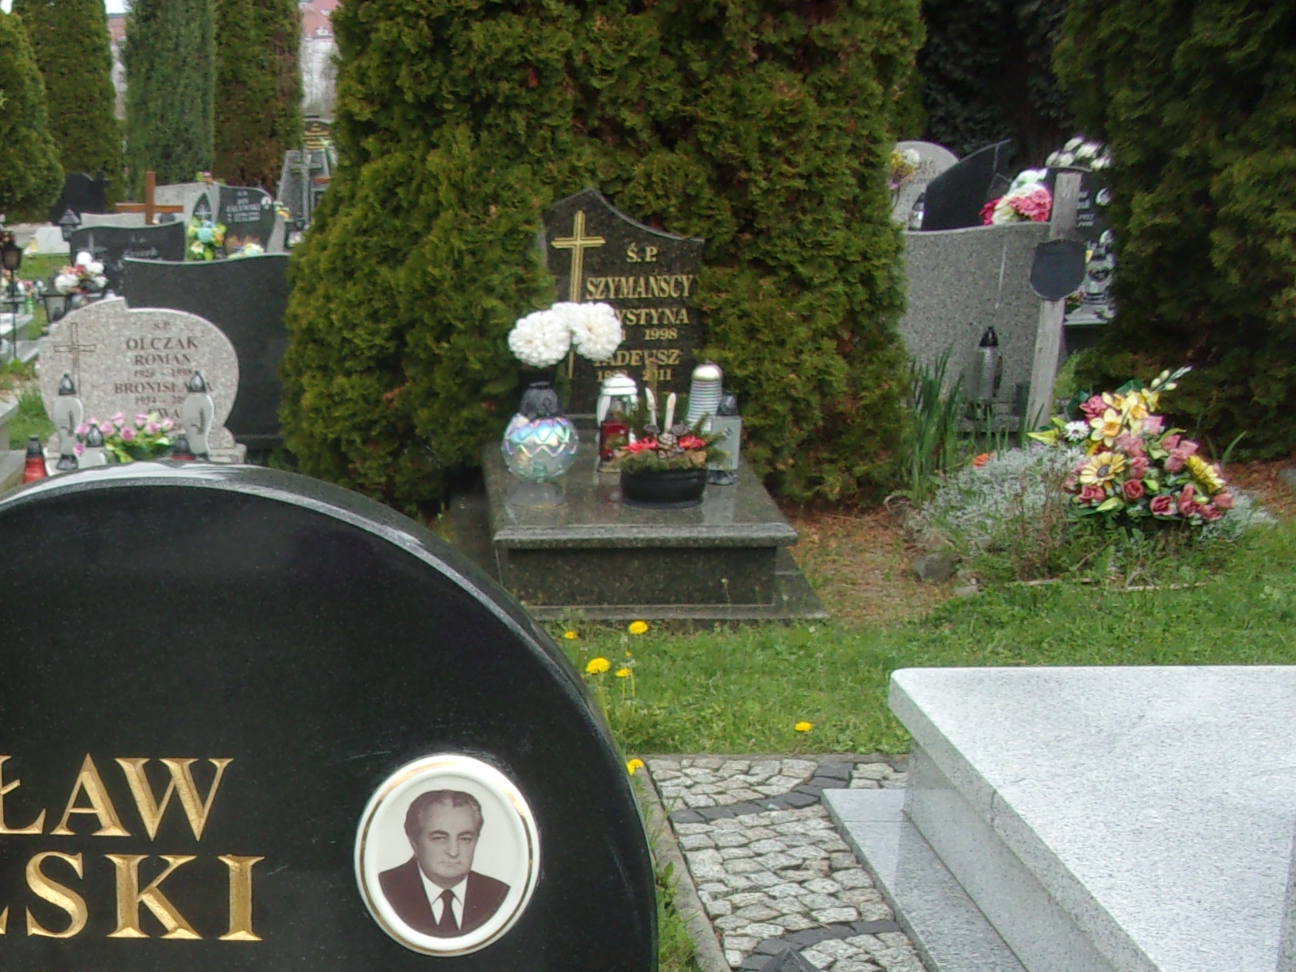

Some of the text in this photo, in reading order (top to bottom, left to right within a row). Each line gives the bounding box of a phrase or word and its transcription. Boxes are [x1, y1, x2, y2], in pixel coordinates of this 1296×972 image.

[615, 308, 689, 326] YSTYNA
[644, 328, 678, 341] 1998
[125, 336, 199, 351] OLCZAK
[134, 353, 192, 366] ROMAN
